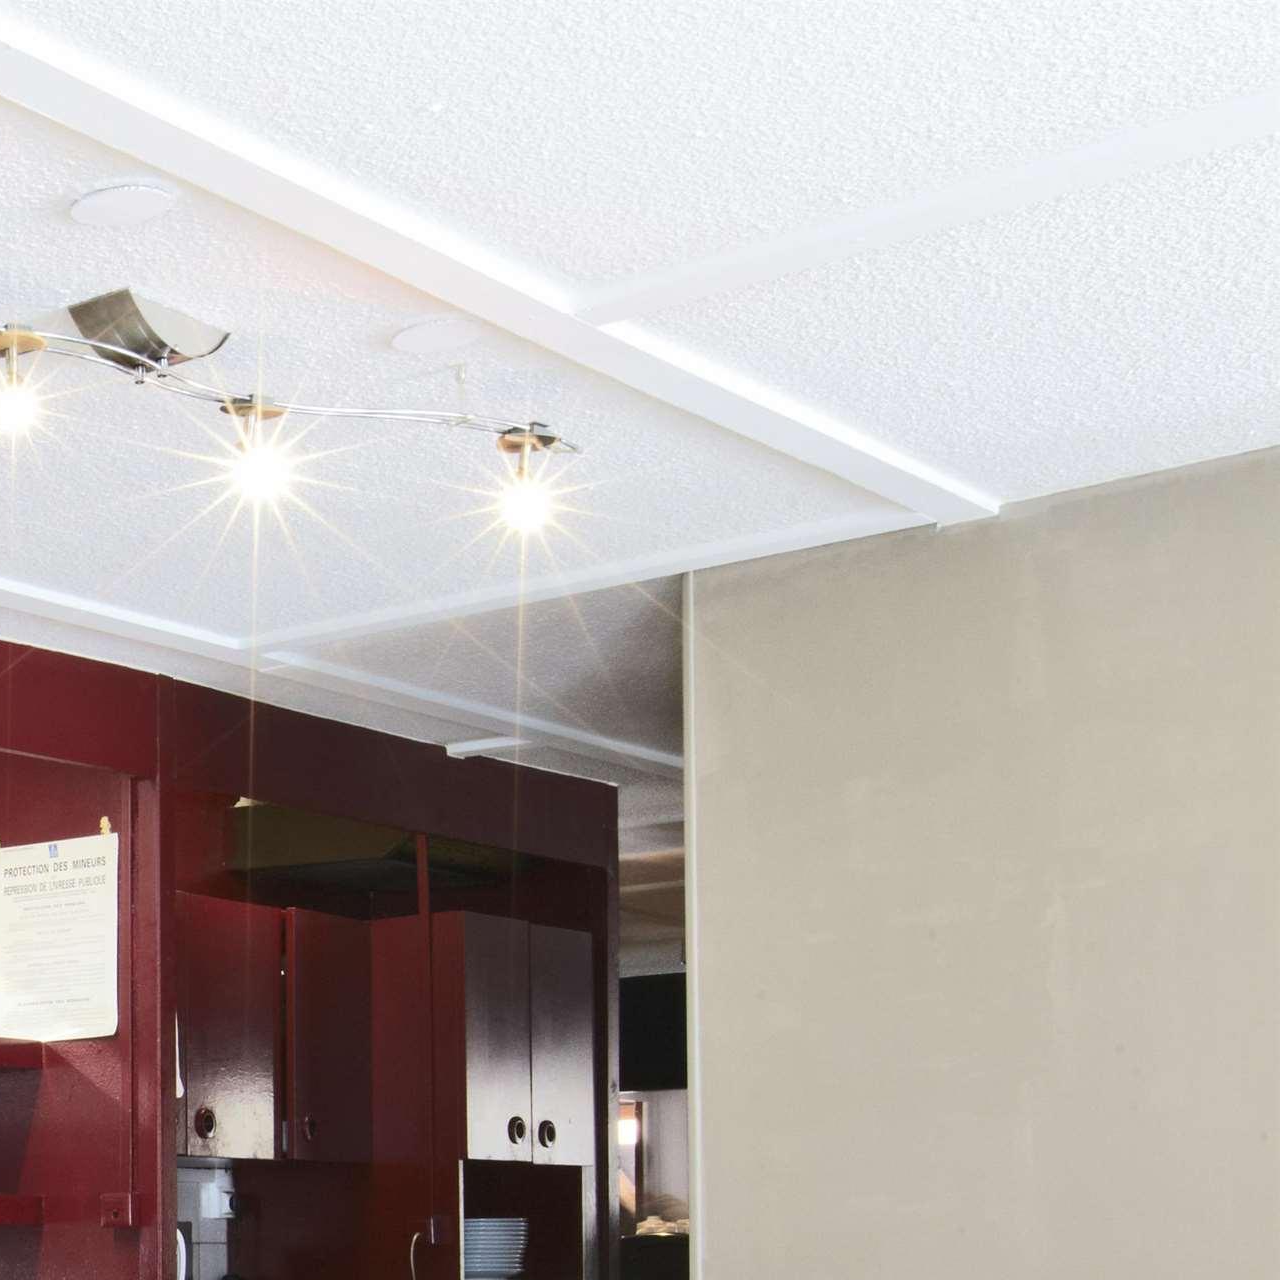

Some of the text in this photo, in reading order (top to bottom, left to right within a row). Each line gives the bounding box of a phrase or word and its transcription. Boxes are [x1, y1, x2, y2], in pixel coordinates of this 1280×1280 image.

[3, 856, 107, 879] PROTECTION DES MINEURS
